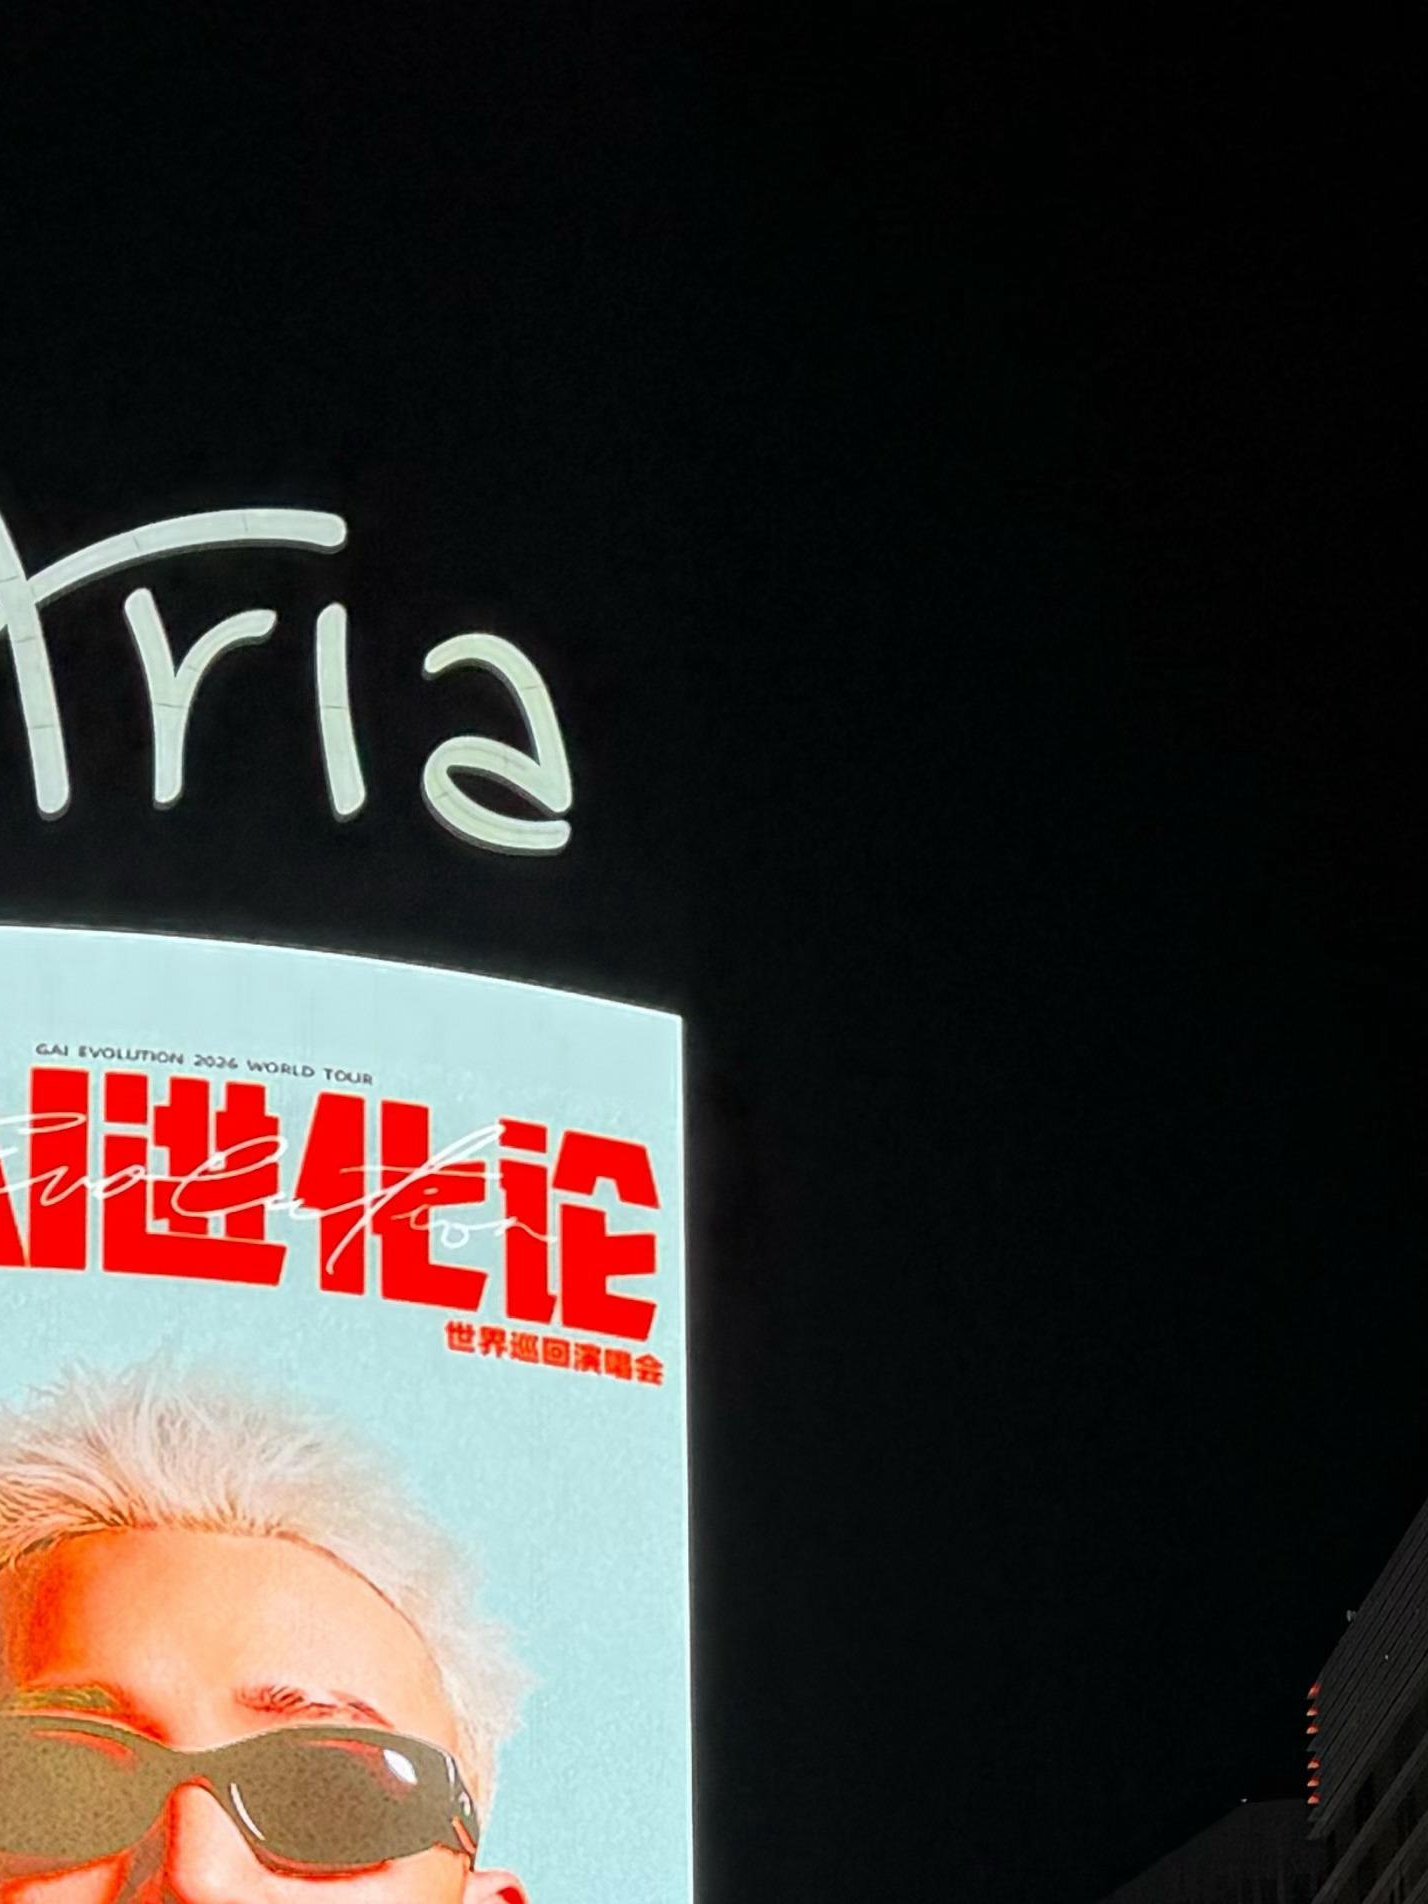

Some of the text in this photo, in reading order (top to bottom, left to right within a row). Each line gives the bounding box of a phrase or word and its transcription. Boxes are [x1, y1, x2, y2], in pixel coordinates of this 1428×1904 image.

[36, 1043, 373, 1086] GAI EVOLUTION 2026 WORLD TOUR
[444, 1321, 665, 1386] 世界巡回演唱会
